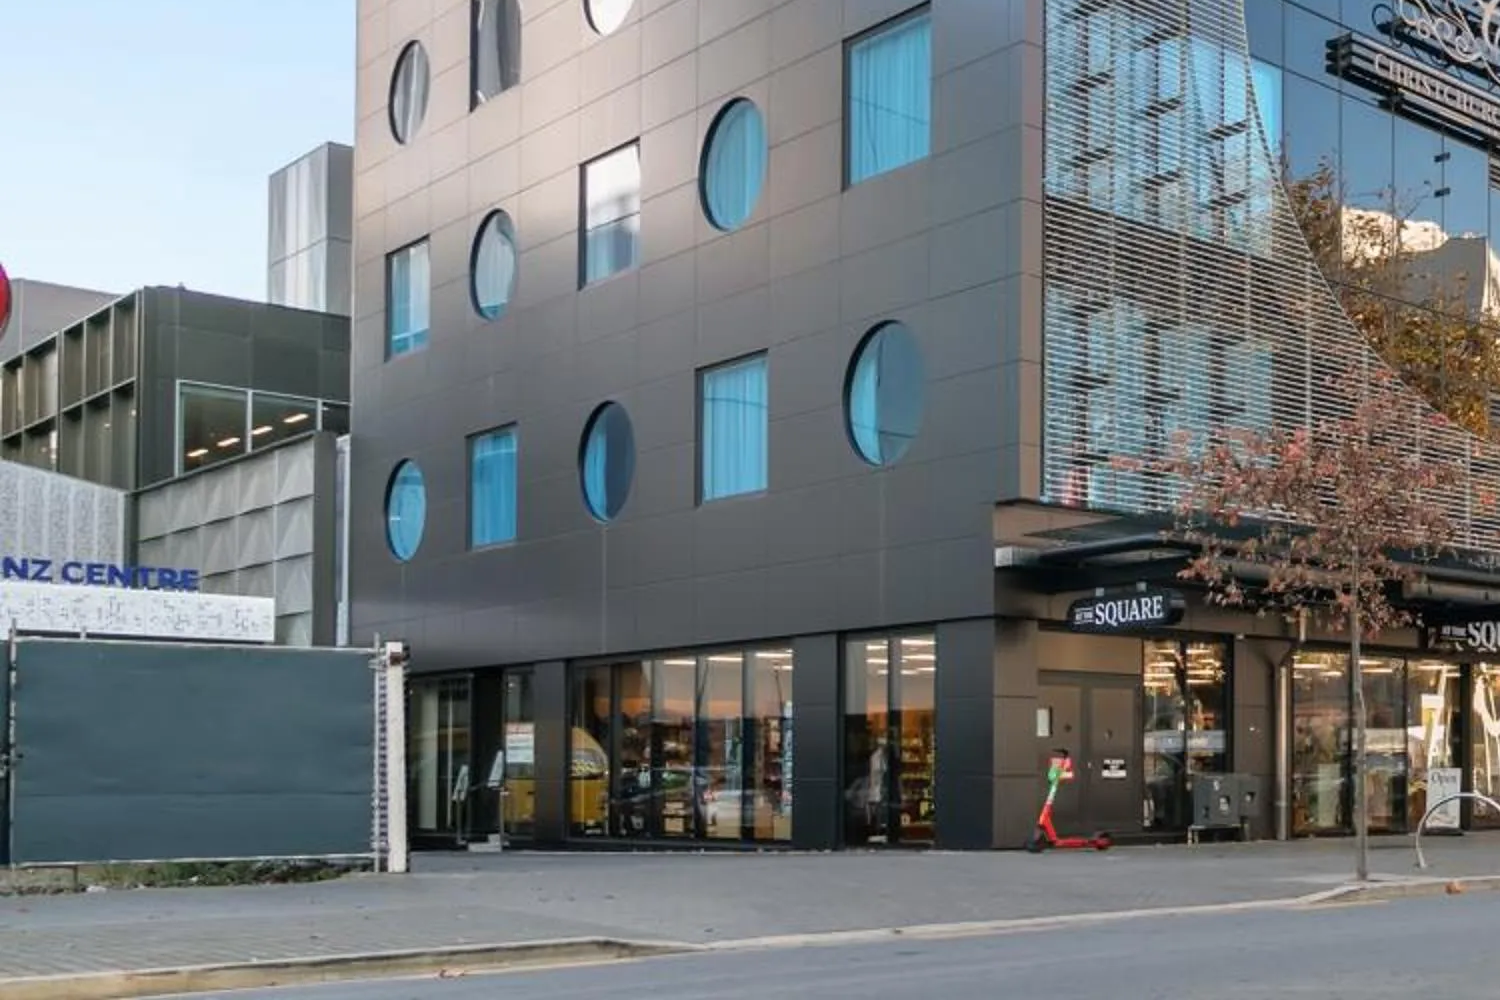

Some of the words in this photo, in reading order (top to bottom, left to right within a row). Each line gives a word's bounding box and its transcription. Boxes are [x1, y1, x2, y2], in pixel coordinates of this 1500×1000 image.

[2, 556, 52, 582] NZ
[61, 561, 200, 590] CENTRE
[1095, 595, 1164, 627] SQUARE
